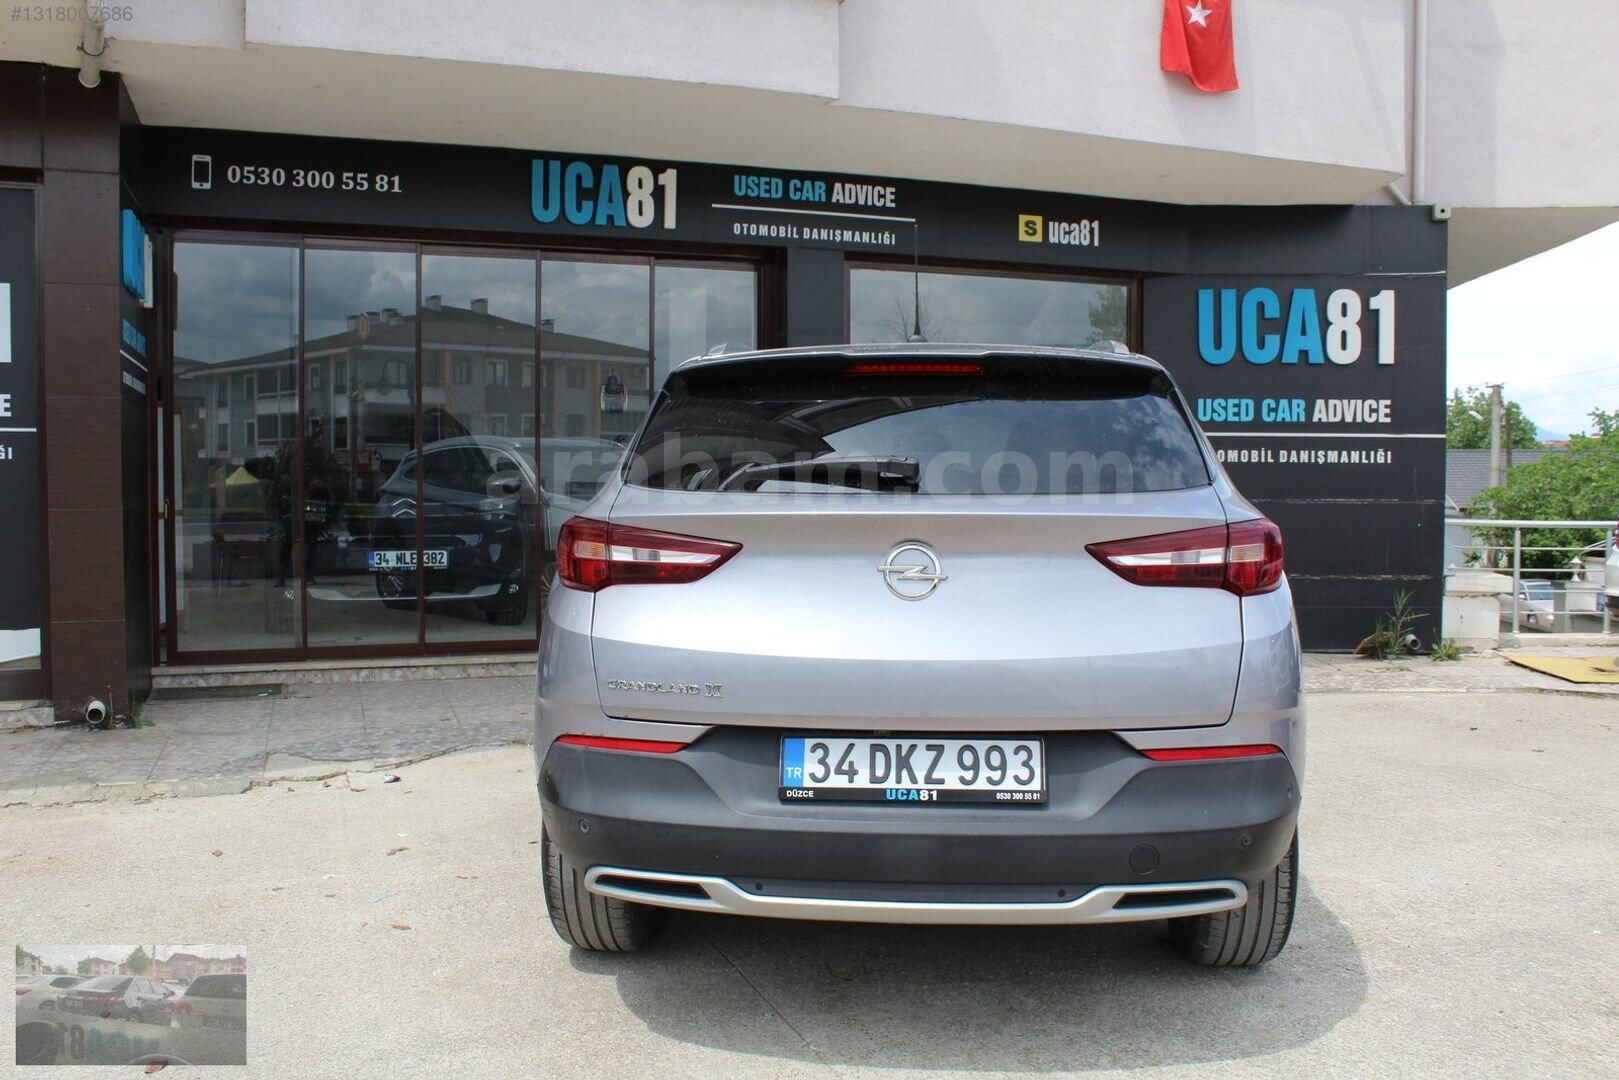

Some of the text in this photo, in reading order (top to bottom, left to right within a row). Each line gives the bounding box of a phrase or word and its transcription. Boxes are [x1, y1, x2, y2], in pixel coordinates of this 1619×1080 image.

[227, 164, 402, 193] 0530 300 55 81
[733, 174, 897, 209] USED CAR ADVICE
[530, 158, 679, 230] UCA81
[733, 222, 896, 245] OTOMOBİL DANIŞMANLIĞI
[1048, 218, 1100, 247] uca81
[1198, 287, 1396, 366] UCA81
[1198, 398, 1392, 423] USED CAR ADVICE
[1216, 447, 1392, 465] OMOBİL DANIŞMANLIĞI
[375, 552, 389, 566] 34
[423, 552, 445, 565] 382
[607, 679, 723, 698] GRANDLAND X
[786, 742, 1036, 786] TR 34 DKZ 993
[786, 789, 814, 798] DÜZCE
[886, 789, 938, 801] UCA81
